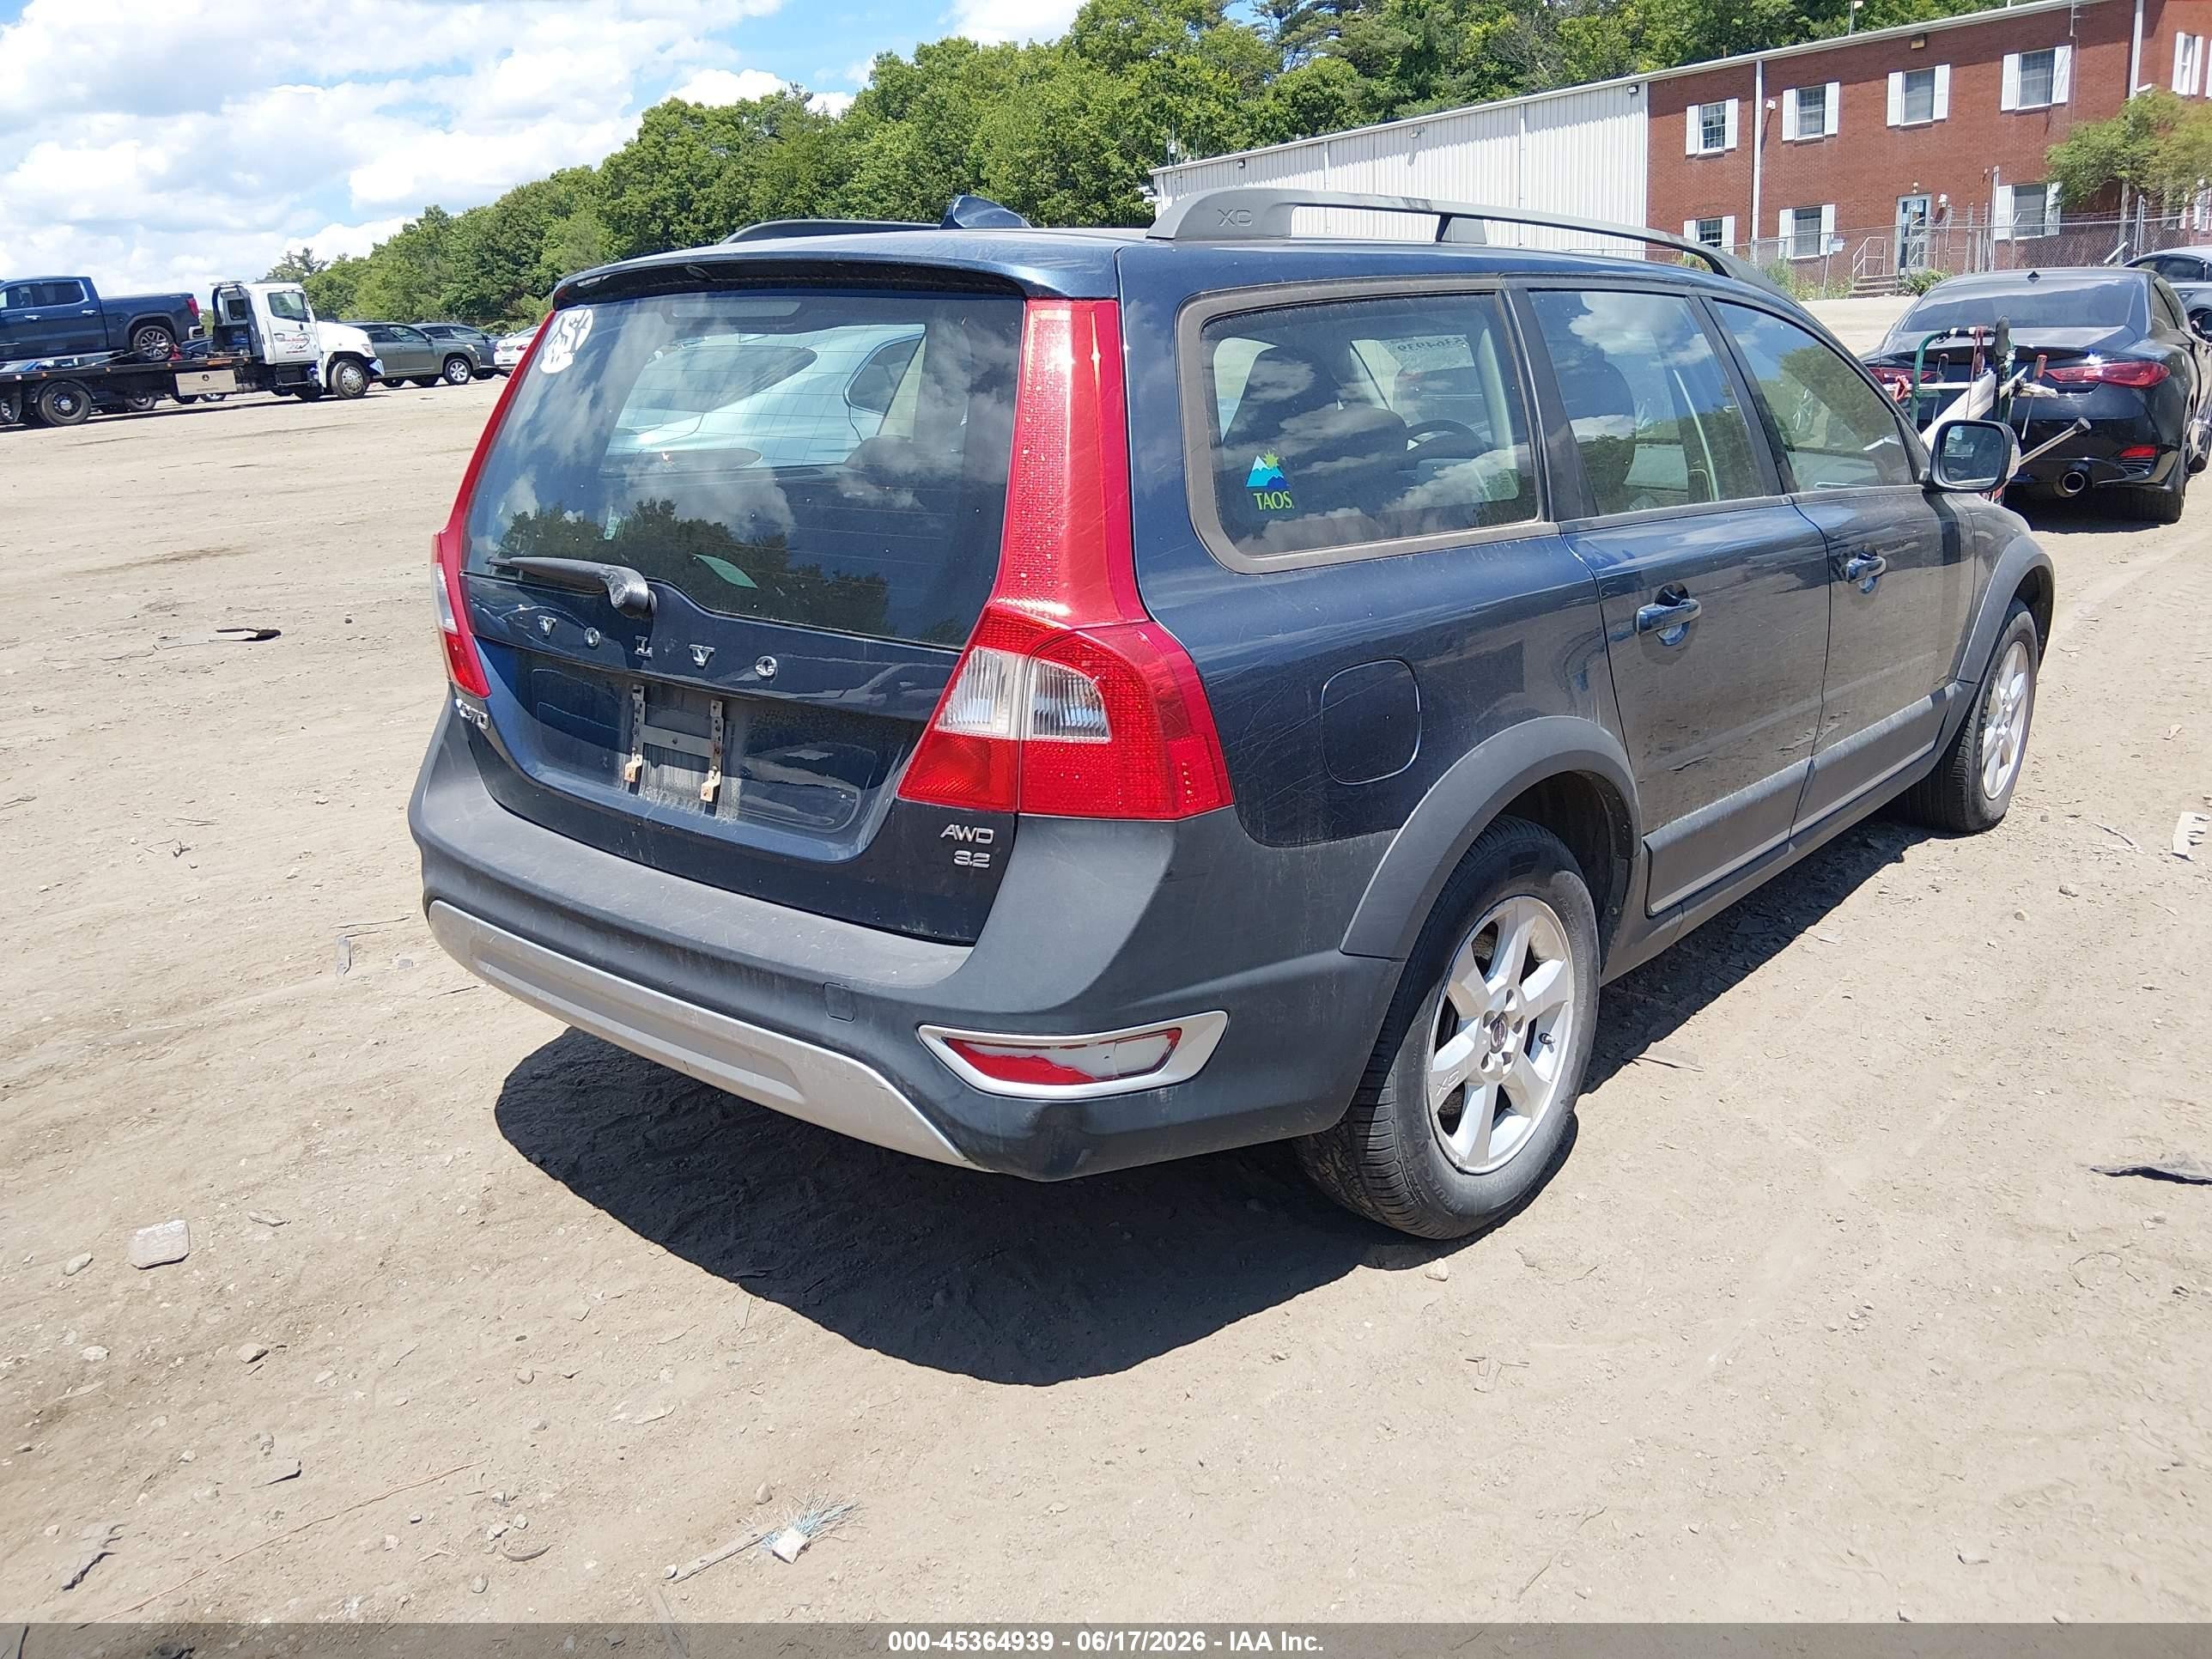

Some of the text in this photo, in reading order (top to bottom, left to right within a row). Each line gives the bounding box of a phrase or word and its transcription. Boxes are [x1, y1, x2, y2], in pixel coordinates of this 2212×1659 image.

[1217, 209, 1252, 227] XC
[1253, 490, 1292, 510] TAOS
[538, 615, 778, 678] VOLVO
[939, 823, 994, 844] AWD
[953, 849, 991, 868] 3.2
